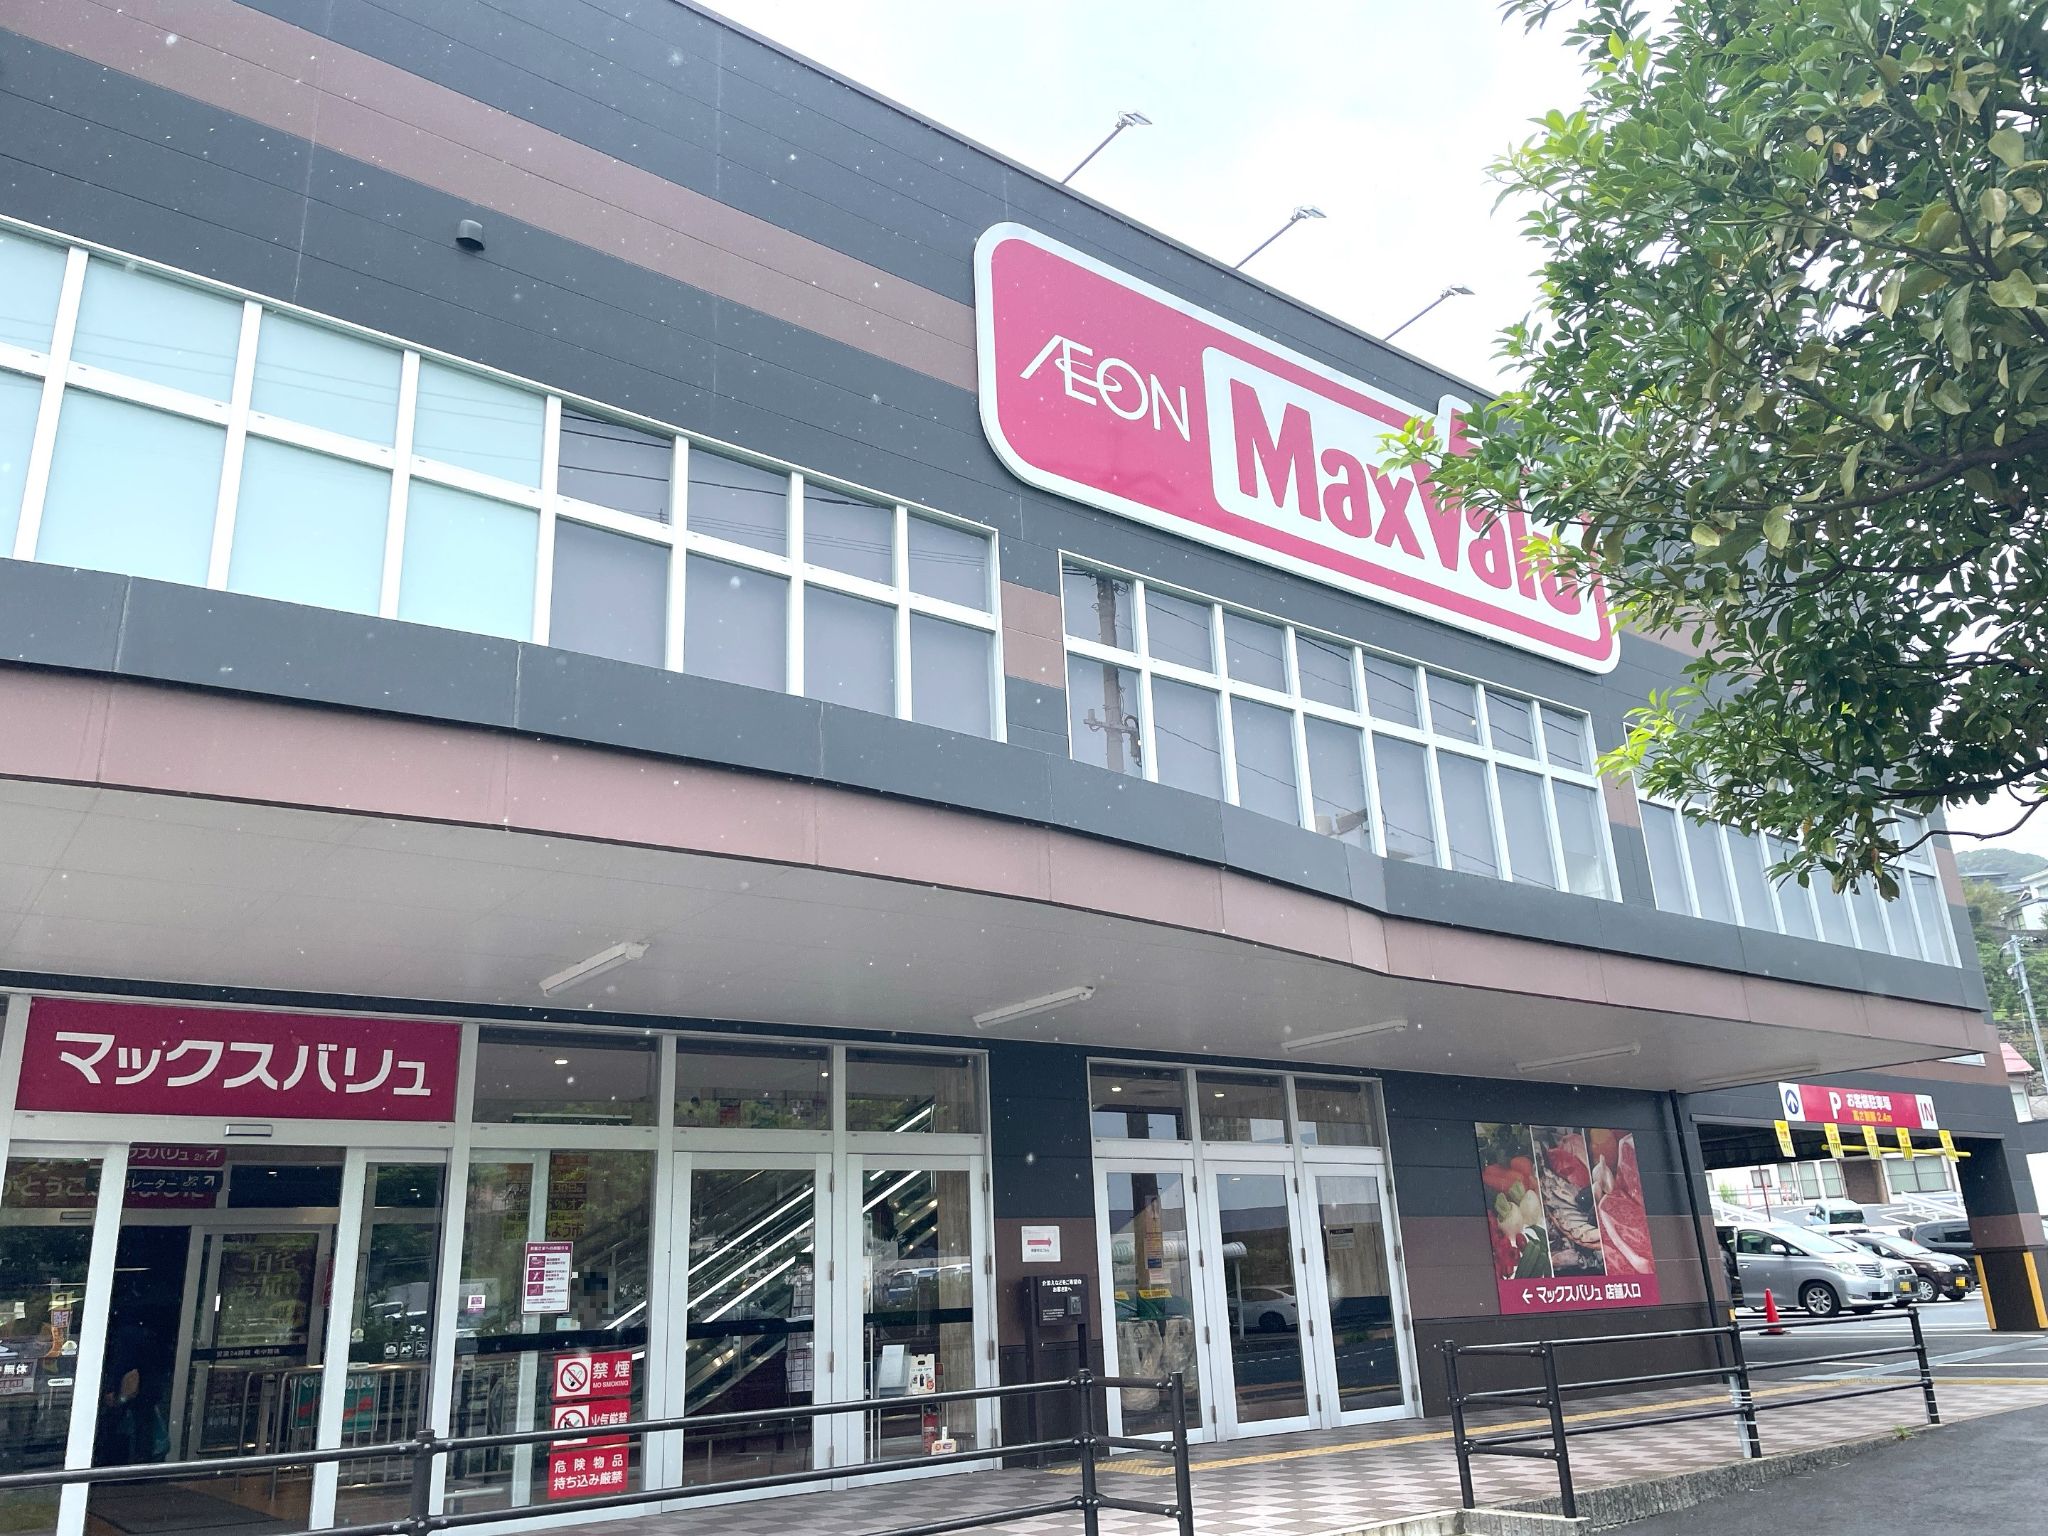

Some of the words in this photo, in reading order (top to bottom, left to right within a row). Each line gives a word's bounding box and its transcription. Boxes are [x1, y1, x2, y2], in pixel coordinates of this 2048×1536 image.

[55, 1031, 432, 1096] マックスバリュ
[1828, 1091, 1842, 1120] P
[1920, 1102, 1935, 1122] IN
[1536, 1284, 1604, 1304] マックスバリュ
[1605, 1283, 1642, 1300] 店舗入口
[592, 1360, 631, 1380] 禁煙
[602, 1380, 629, 1388] SMOKING
[554, 1453, 624, 1474] 危険物品
[553, 1470, 623, 1491] 持ち込み厳禁
